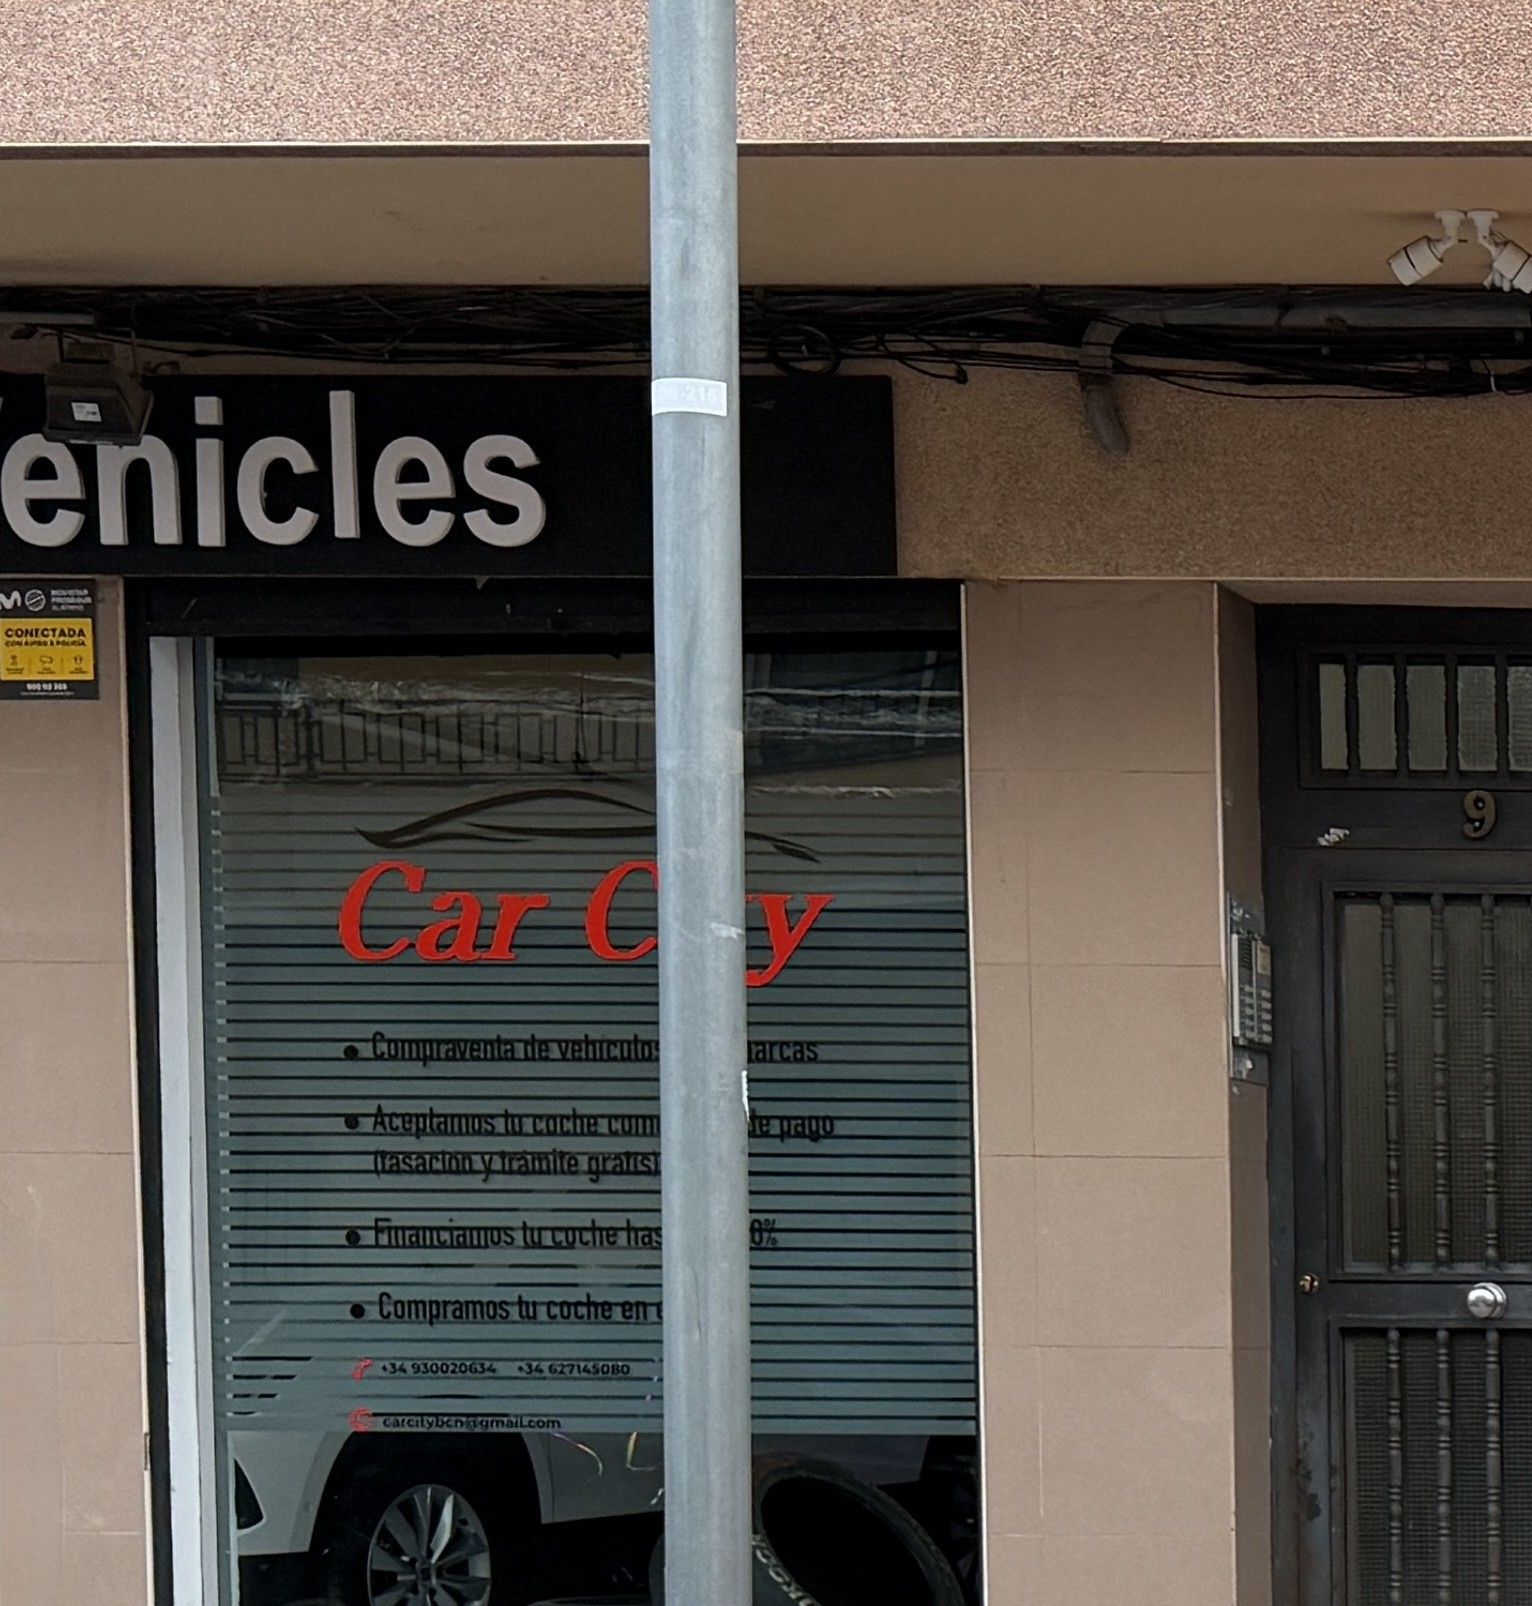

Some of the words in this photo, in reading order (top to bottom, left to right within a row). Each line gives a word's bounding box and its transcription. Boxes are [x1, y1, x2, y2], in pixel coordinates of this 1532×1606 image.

[5, 627, 87, 639] CONECTADA
[1464, 790, 1496, 838] 9
[338, 860, 549, 962] Car
[585, 860, 834, 987] Cy
[372, 1031, 515, 1067] Compraventa
[523, 1033, 550, 1062] de
[373, 1103, 497, 1140] Aceptamos
[504, 1108, 523, 1136] tu
[532, 1107, 598, 1136] coche
[779, 1113, 835, 1143] pago
[480, 1151, 494, 1183] y
[374, 1217, 515, 1248] Financiamos
[522, 1220, 543, 1247] tu
[551, 1218, 618, 1248] coche
[379, 1291, 510, 1327] Compramos
[518, 1294, 537, 1321] tu
[546, 1292, 613, 1322] coche
[621, 1300, 648, 1322] en
[411, 1360, 497, 1375] 930020634
